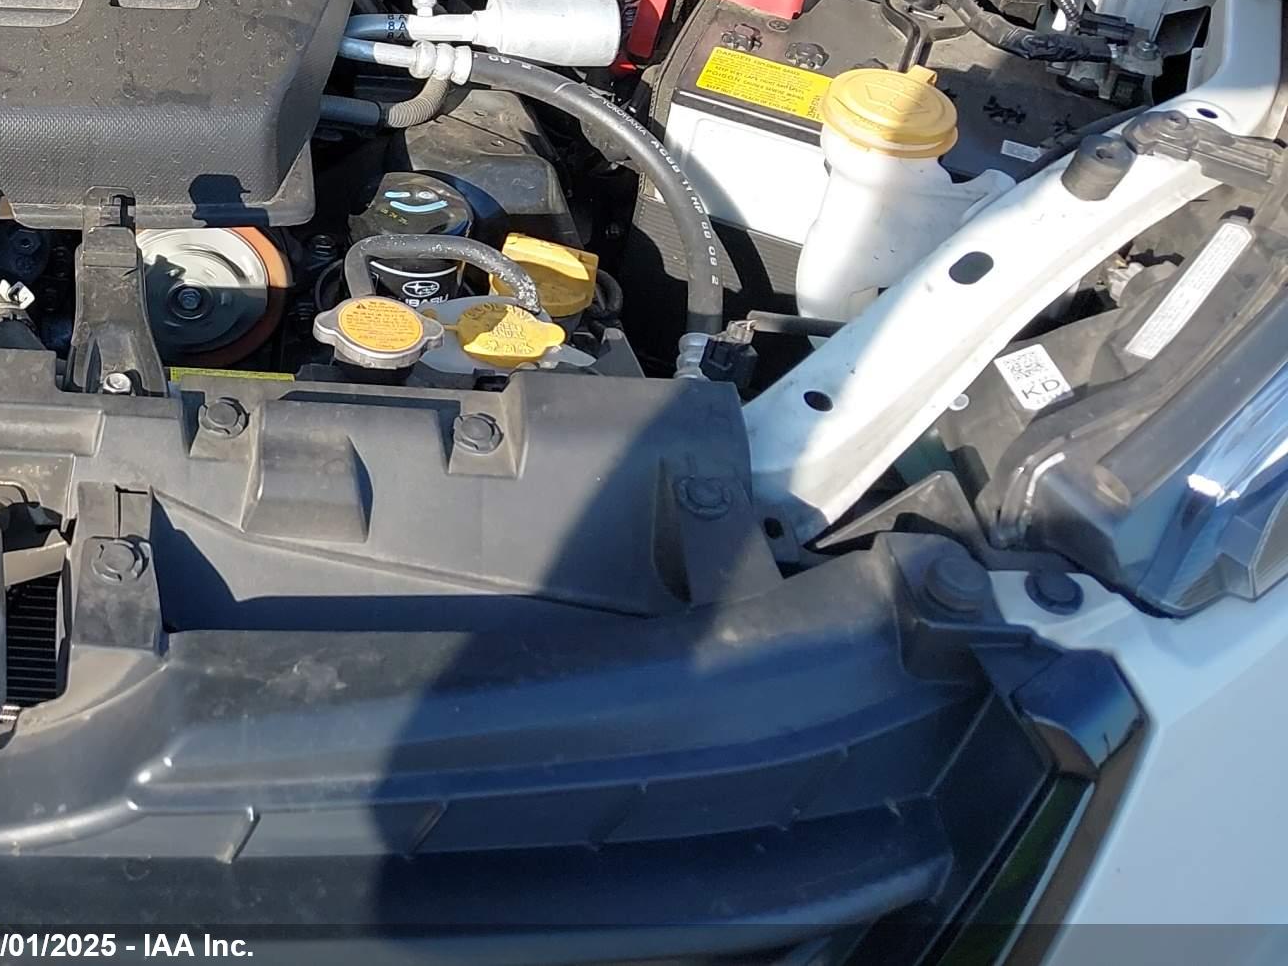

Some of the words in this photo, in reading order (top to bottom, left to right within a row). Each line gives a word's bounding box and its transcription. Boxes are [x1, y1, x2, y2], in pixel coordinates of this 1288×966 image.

[716, 49, 752, 62] DANGER
[706, 69, 741, 83] POISON
[601, 99, 648, 136] YOKOHAMA
[690, 196, 704, 214] HP
[1020, 378, 1061, 400] KD
